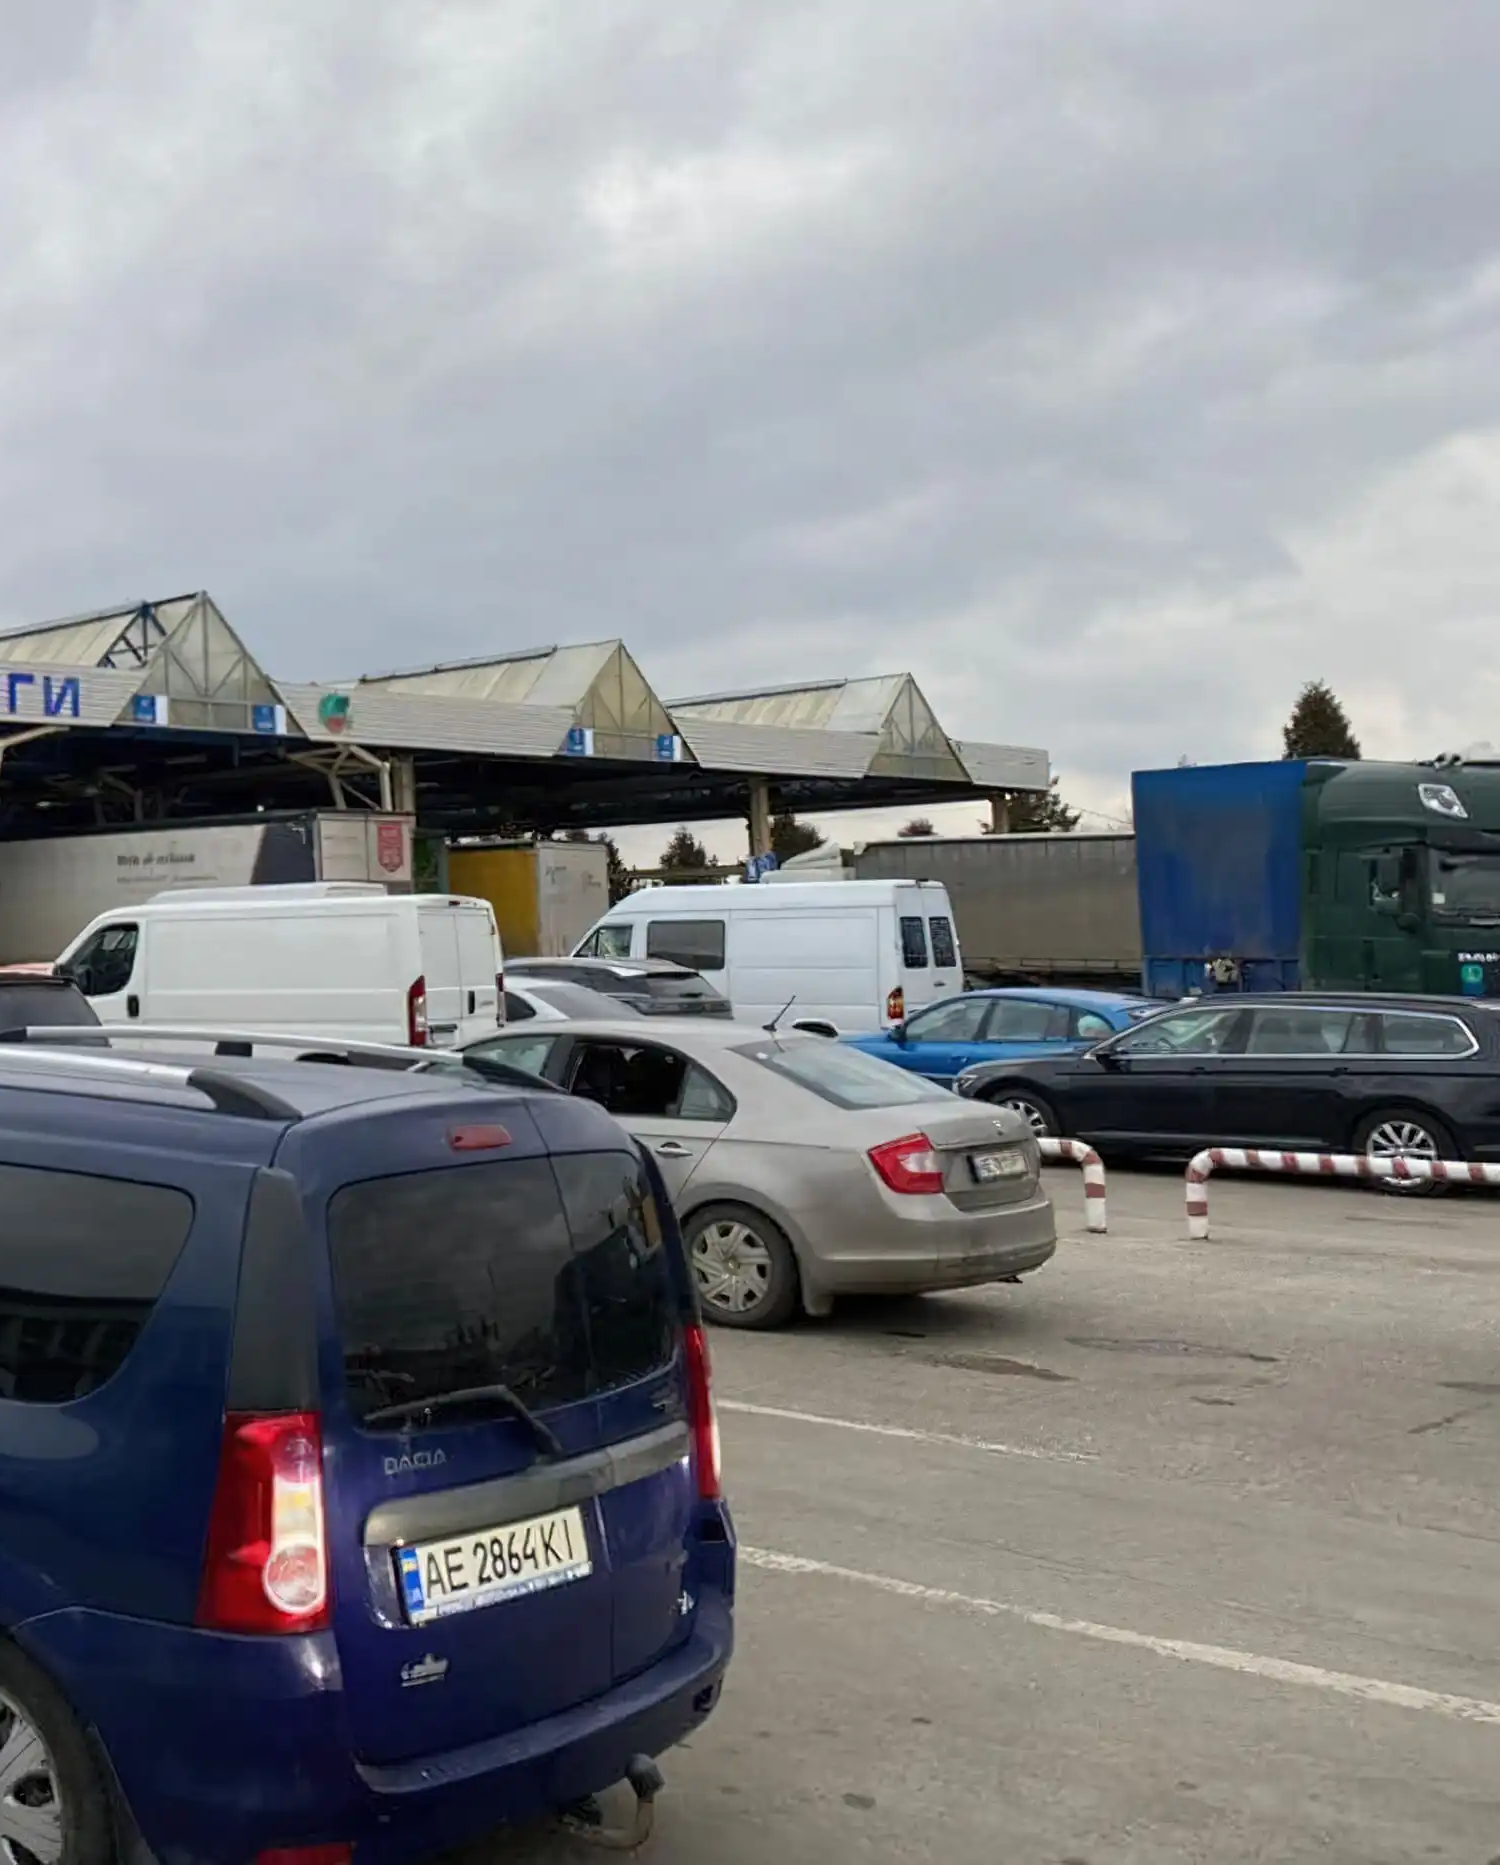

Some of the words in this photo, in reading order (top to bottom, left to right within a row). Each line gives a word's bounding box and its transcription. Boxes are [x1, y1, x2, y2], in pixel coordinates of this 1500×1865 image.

[384, 1448, 447, 1475] DACIA
[425, 1546, 470, 1600] AE
[472, 1526, 540, 1587] 2864
